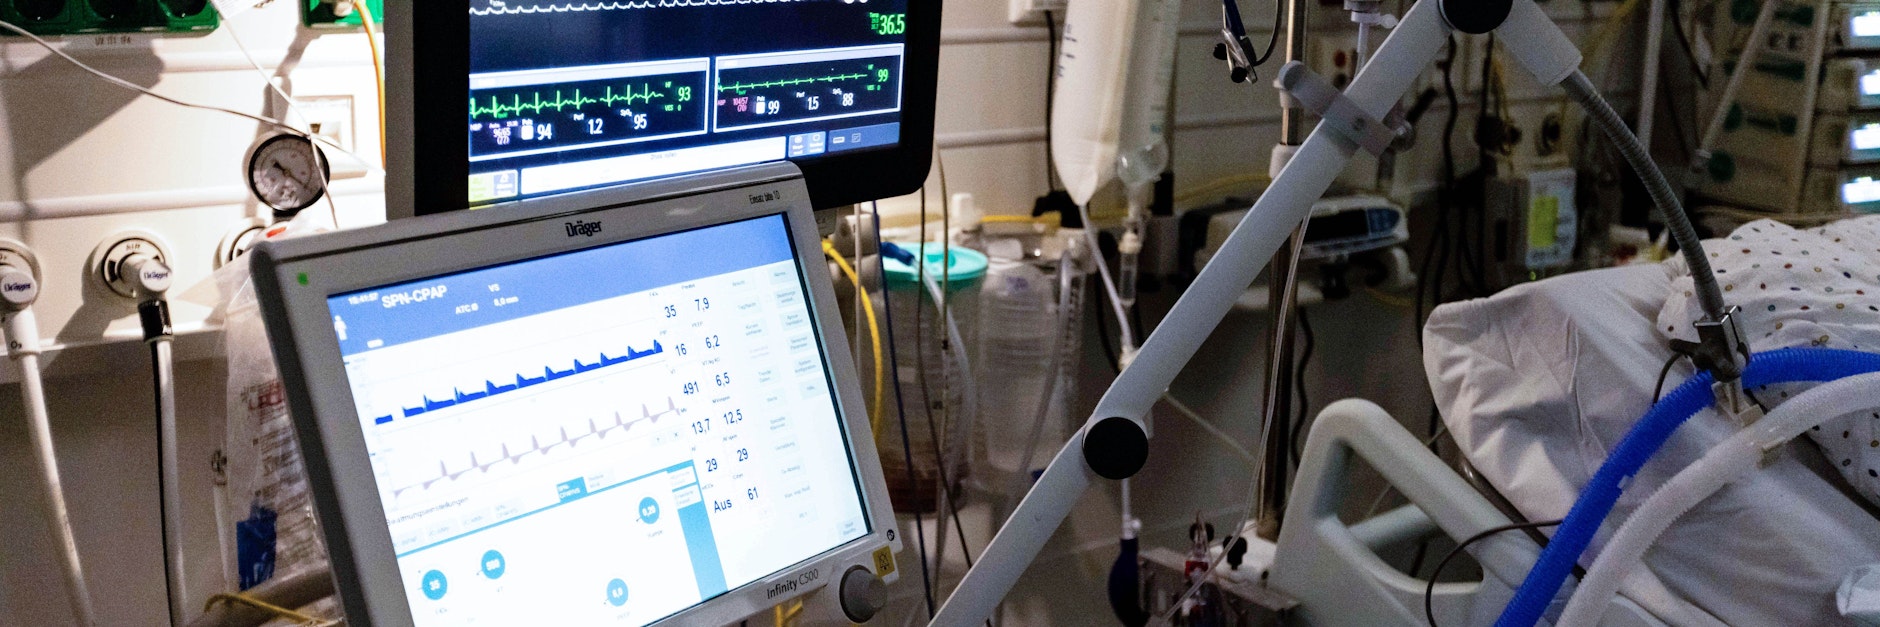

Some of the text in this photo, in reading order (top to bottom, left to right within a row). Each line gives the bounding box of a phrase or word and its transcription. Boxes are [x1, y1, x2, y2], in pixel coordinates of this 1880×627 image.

[879, 14, 906, 35] 36.5
[877, 68, 889, 82] 99
[678, 86, 691, 101] 93
[843, 93, 854, 106] 88
[664, 104, 674, 112] VES
[768, 100, 780, 115] 99
[634, 114, 647, 129] 95
[537, 123, 552, 140] 94
[566, 220, 602, 237] Dräger
[381, 285, 447, 309] SPN-CPAP
[455, 304, 471, 314] ATC
[664, 297, 710, 318] 35 7,9
[675, 334, 720, 357] 16 6,2
[683, 372, 730, 396] 491 6,5
[692, 409, 743, 435] 13,7 12,5
[706, 448, 749, 472] 29 29
[713, 486, 759, 514] Aus 61
[767, 568, 819, 599] Infinity C500
